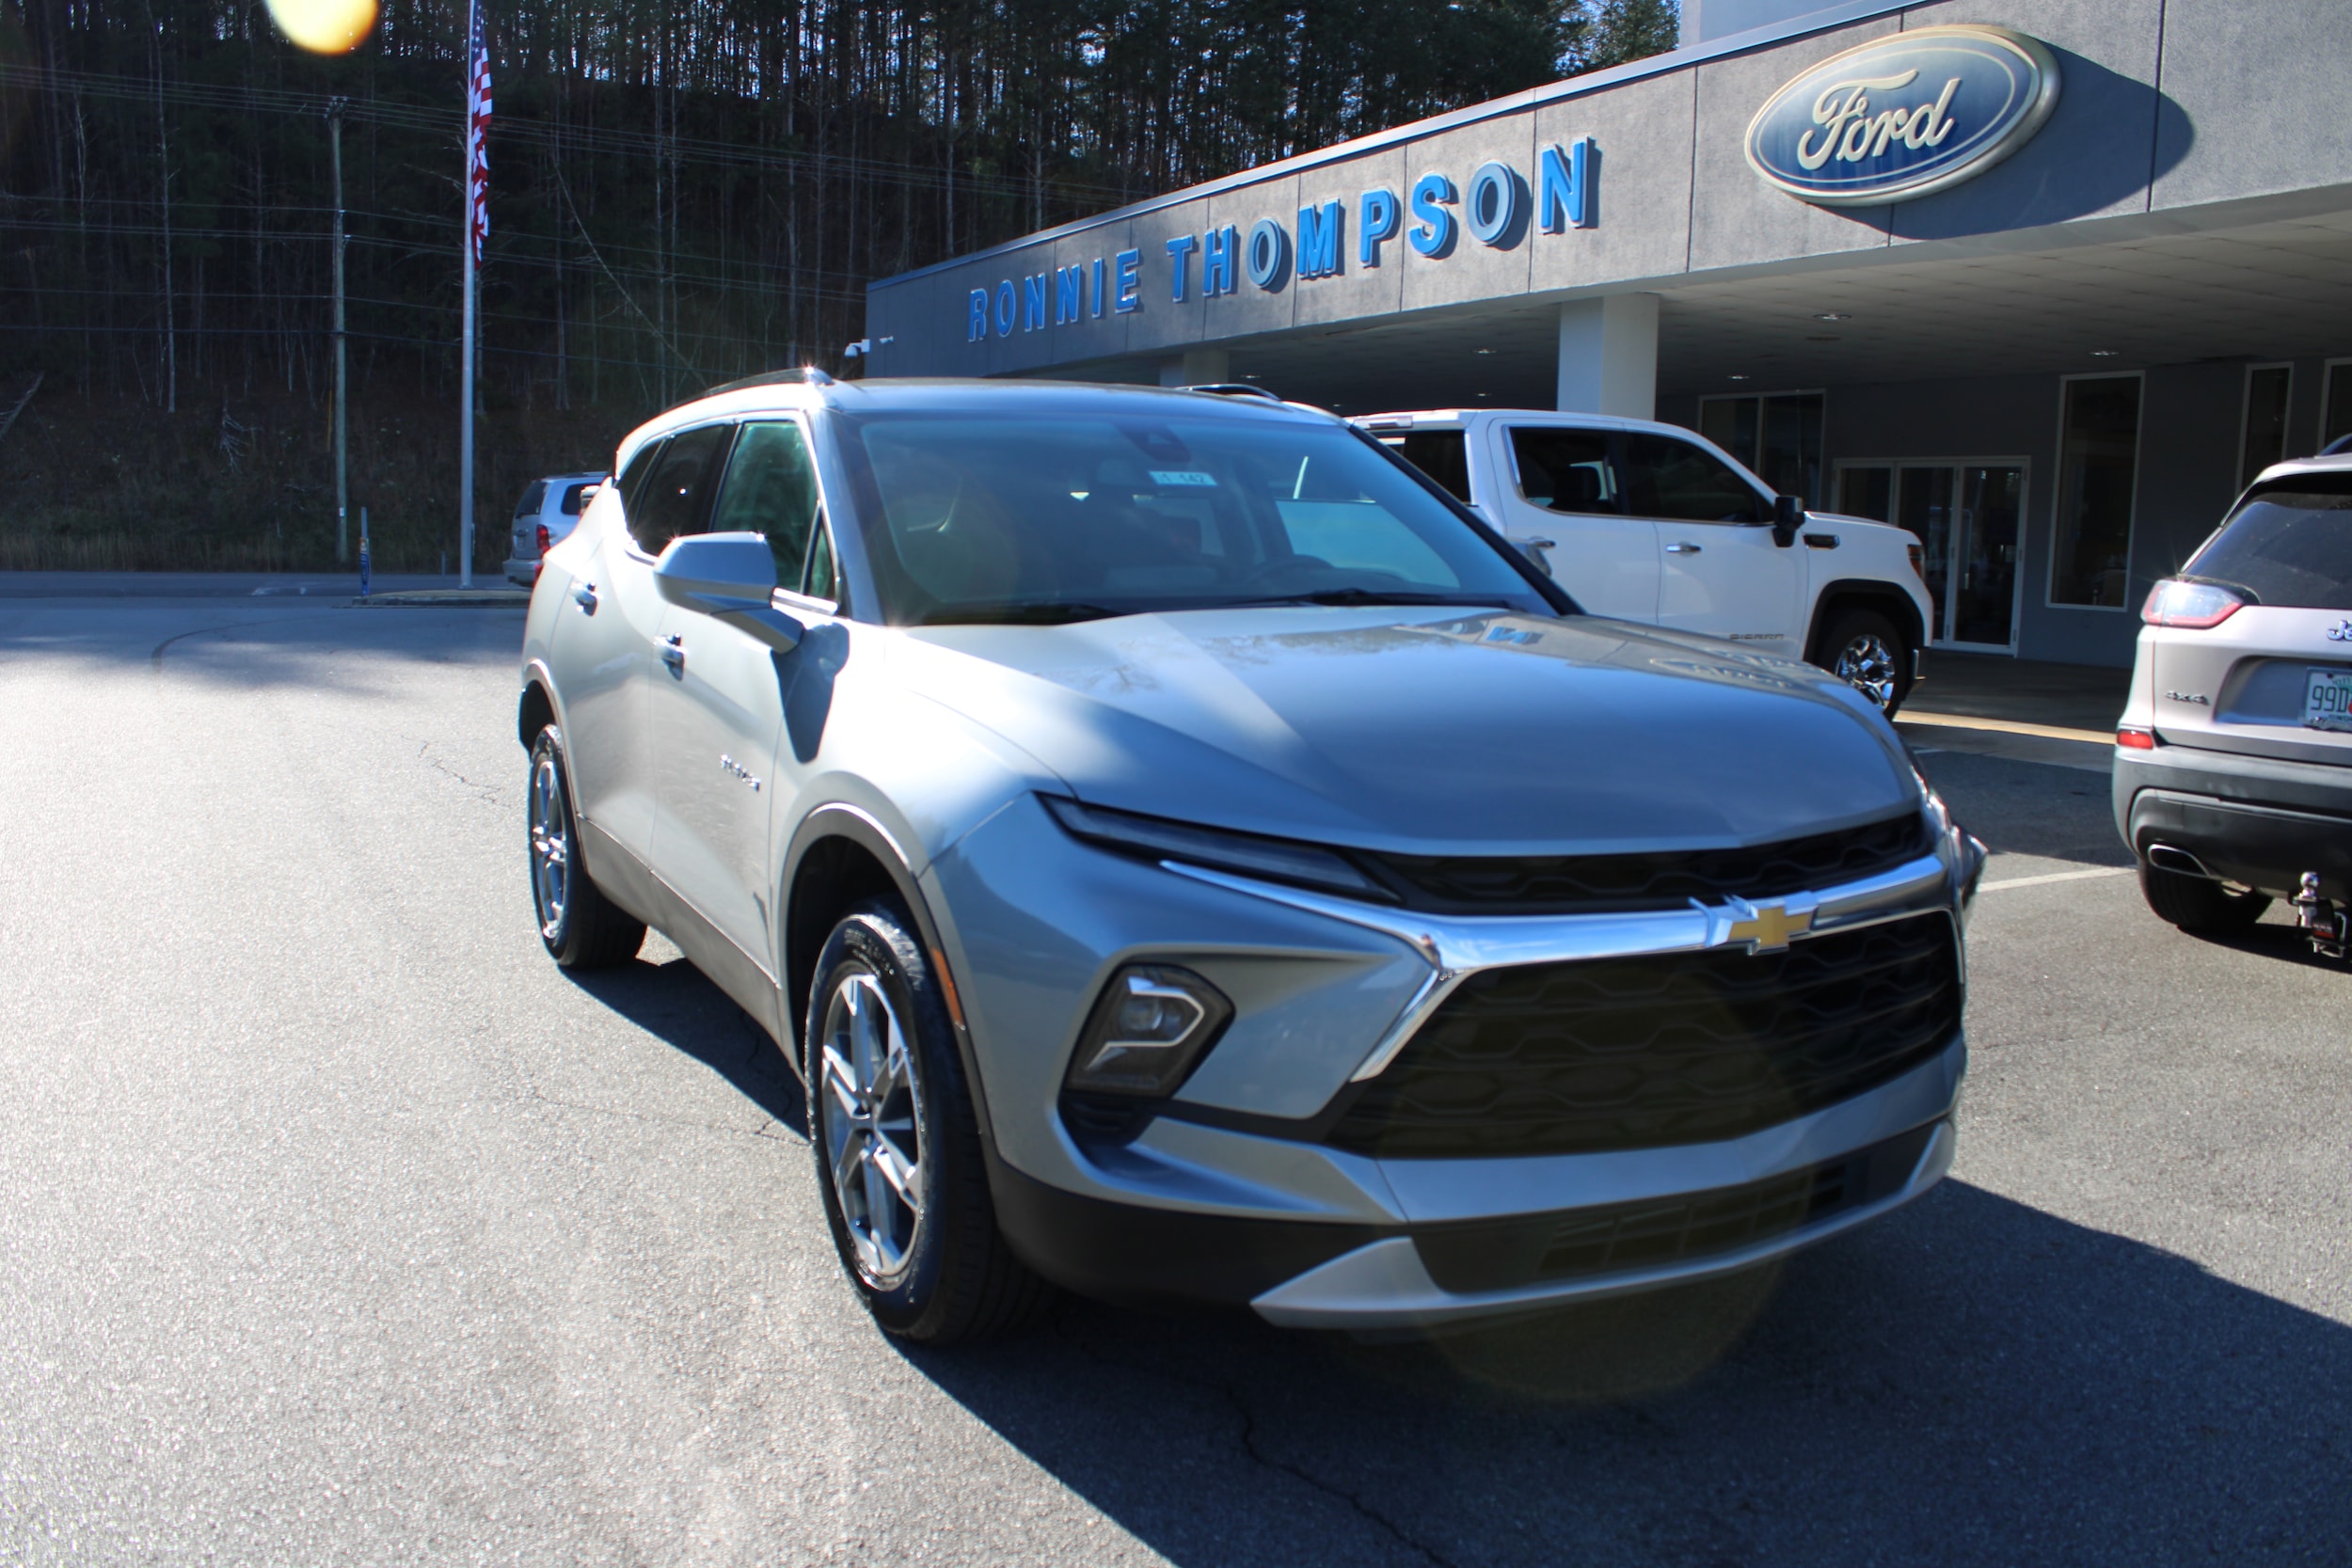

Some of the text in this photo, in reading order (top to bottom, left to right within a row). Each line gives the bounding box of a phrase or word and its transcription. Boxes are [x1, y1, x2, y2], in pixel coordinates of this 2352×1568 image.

[1798, 69, 1962, 171] Ford
[968, 135, 1596, 342] RONNIE THOMPSON
[2311, 685, 2349, 712] 99D
